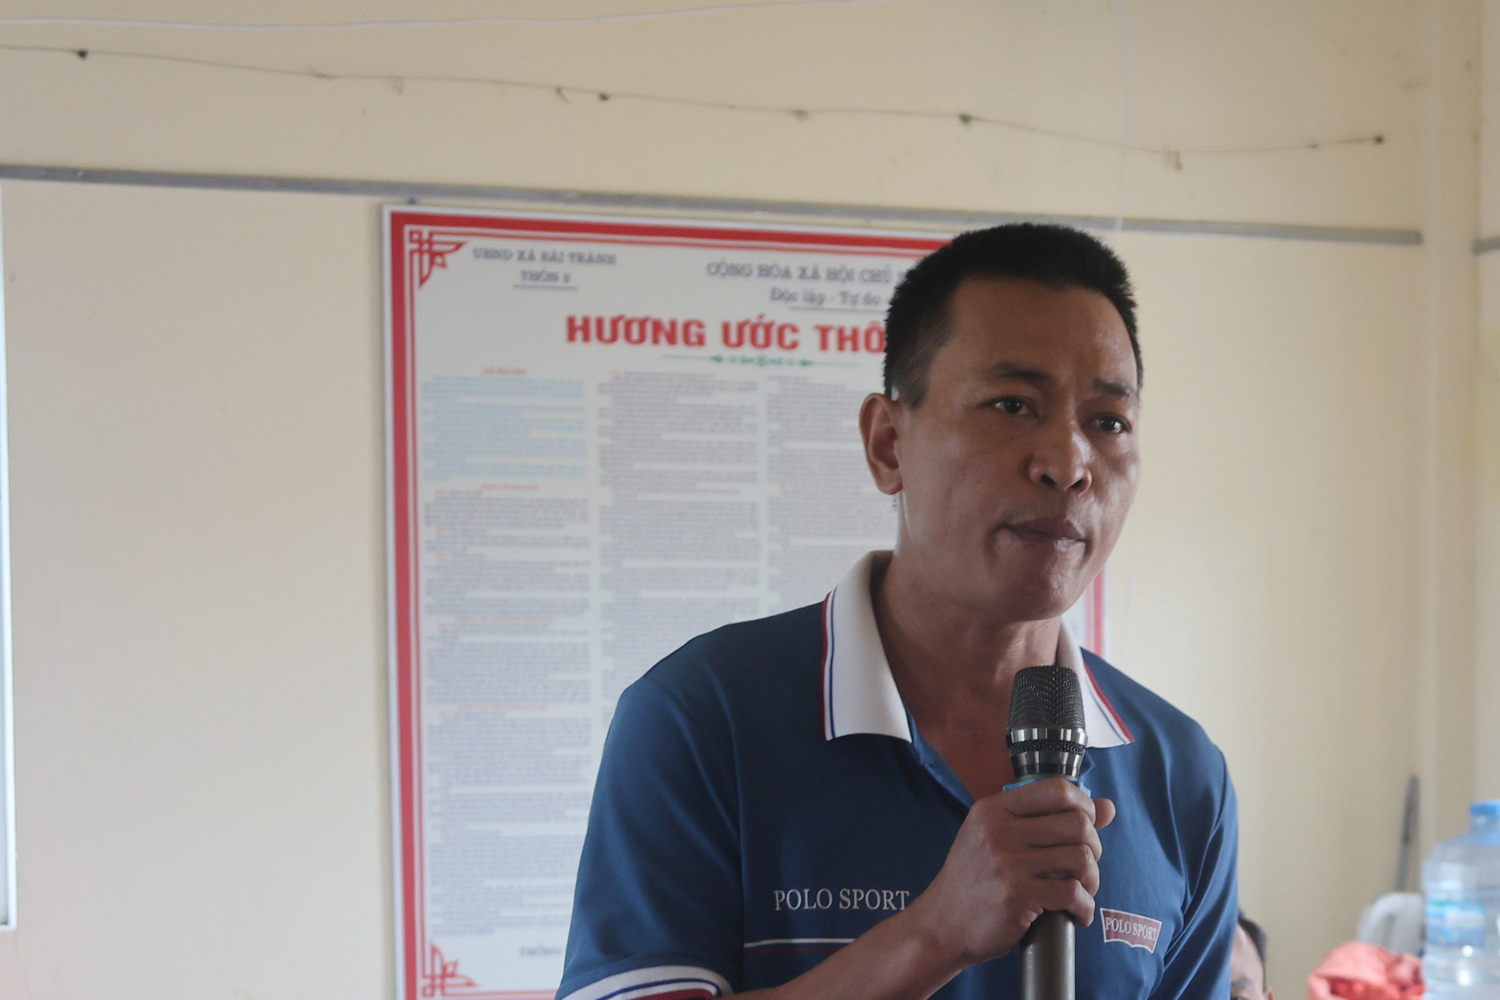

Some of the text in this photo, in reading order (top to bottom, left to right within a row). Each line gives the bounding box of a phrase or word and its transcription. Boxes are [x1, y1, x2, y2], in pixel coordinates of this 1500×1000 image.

[565, 313, 887, 353] HƯƠNG ƯỚC THÔ
[773, 887, 910, 911] POLO SPORT
[1104, 916, 1159, 942] POLO SPORT
